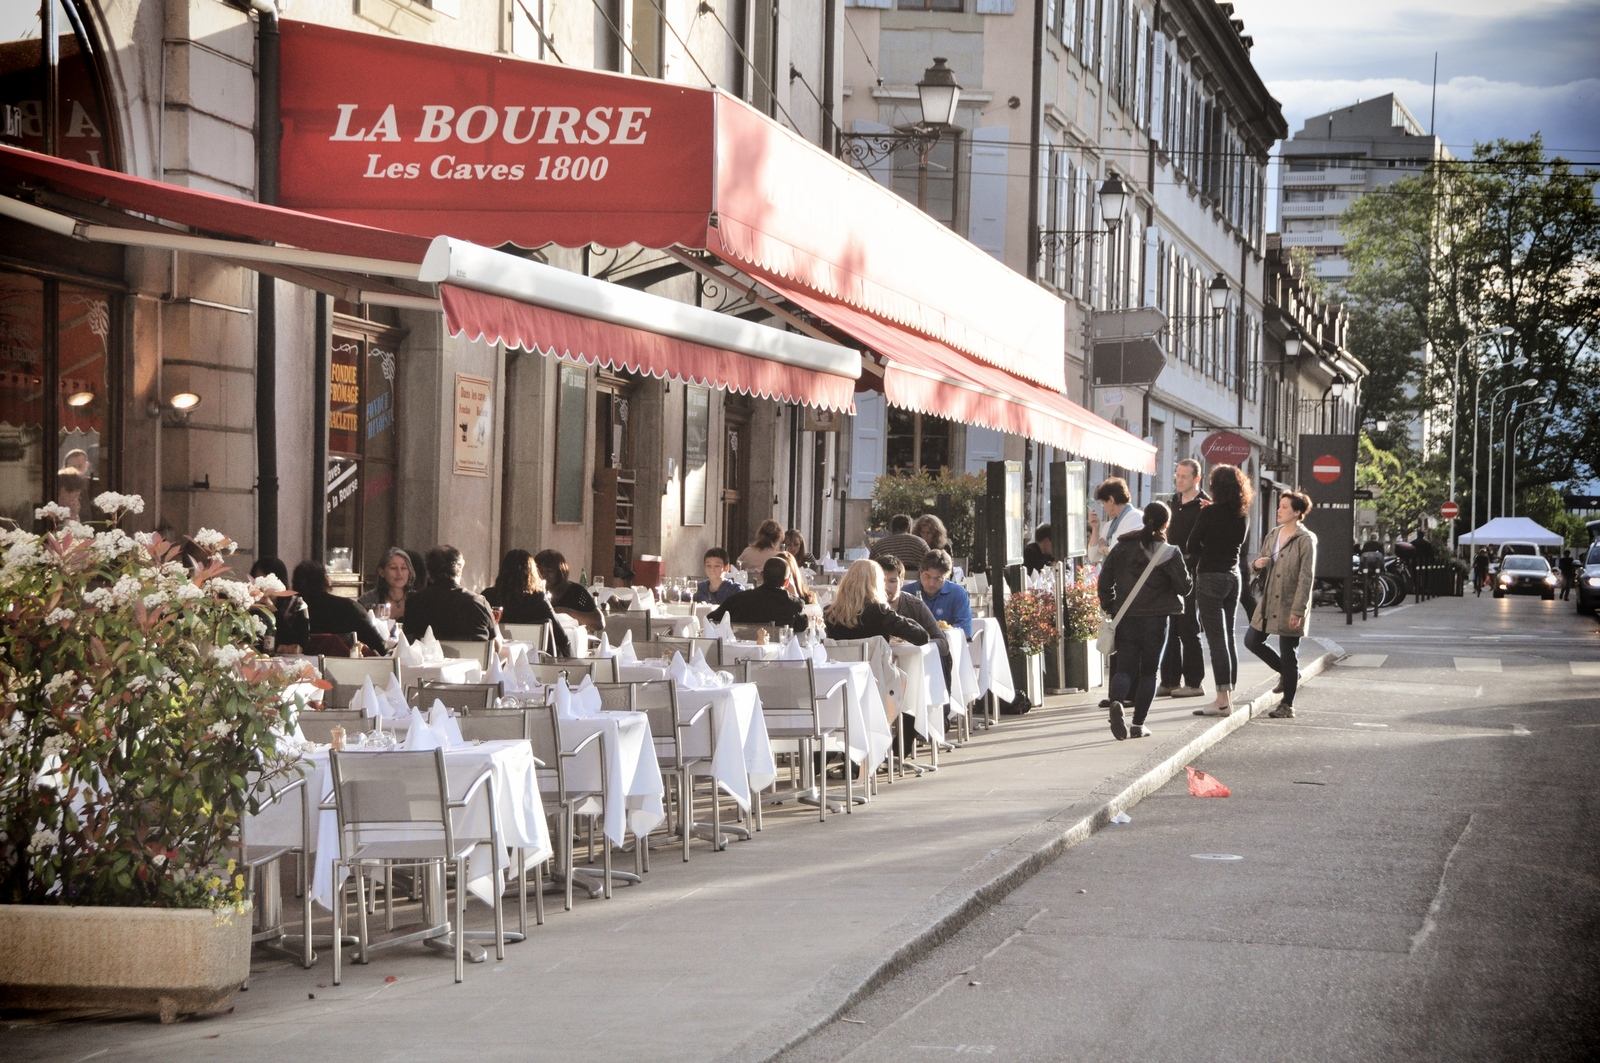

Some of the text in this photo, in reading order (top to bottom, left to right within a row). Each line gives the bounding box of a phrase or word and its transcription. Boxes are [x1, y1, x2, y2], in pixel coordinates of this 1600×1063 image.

[329, 103, 652, 146] LA BOURSE
[363, 154, 609, 182] Les Caves 1800
[332, 364, 357, 384] FONDUE
[328, 463, 342, 483] aves
[332, 495, 339, 509] la
[339, 478, 359, 503] Bourse
